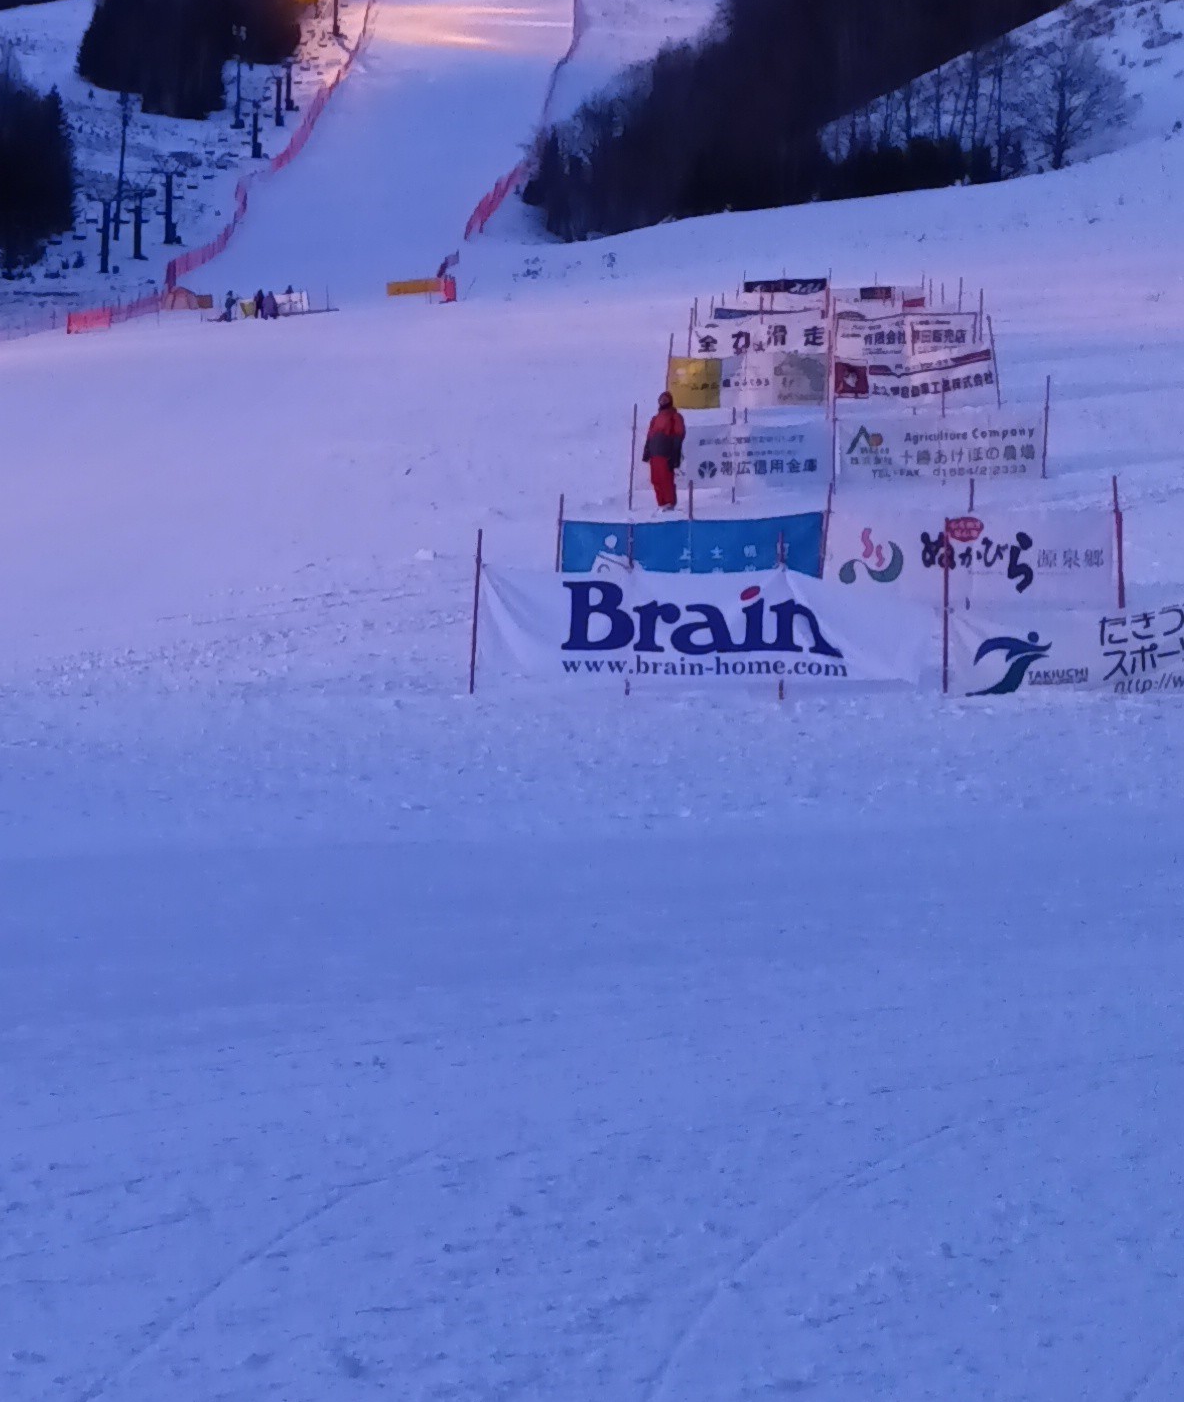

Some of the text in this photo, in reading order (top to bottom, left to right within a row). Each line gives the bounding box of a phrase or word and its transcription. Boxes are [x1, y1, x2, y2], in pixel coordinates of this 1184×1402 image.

[698, 324, 825, 355] 全力滑走
[904, 427, 1035, 445] Agriculture Company
[920, 531, 1034, 594] ぬかびら
[561, 580, 844, 659] Brain
[562, 654, 848, 677] www.brain-home.com
[1028, 667, 1089, 680] TAKIUCHI
[1103, 637, 1184, 681] スポー
